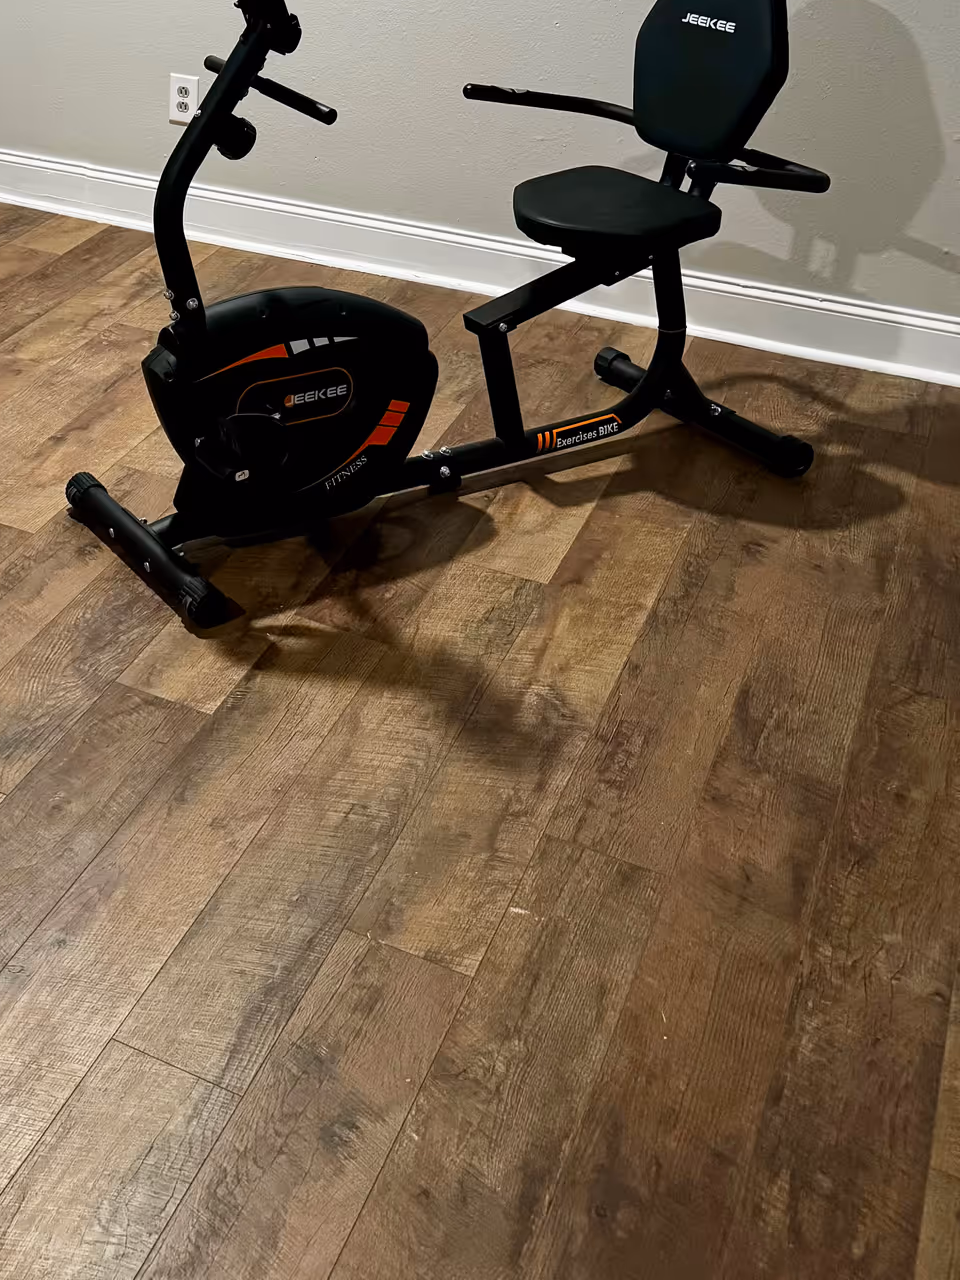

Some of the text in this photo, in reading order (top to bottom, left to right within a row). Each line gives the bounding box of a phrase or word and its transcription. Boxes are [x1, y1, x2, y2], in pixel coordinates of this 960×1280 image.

[681, 12, 736, 33] JEEKEE
[284, 384, 348, 408] JEEKEE
[556, 422, 619, 448] Exercises BIKE
[325, 455, 368, 490] FITNESS
